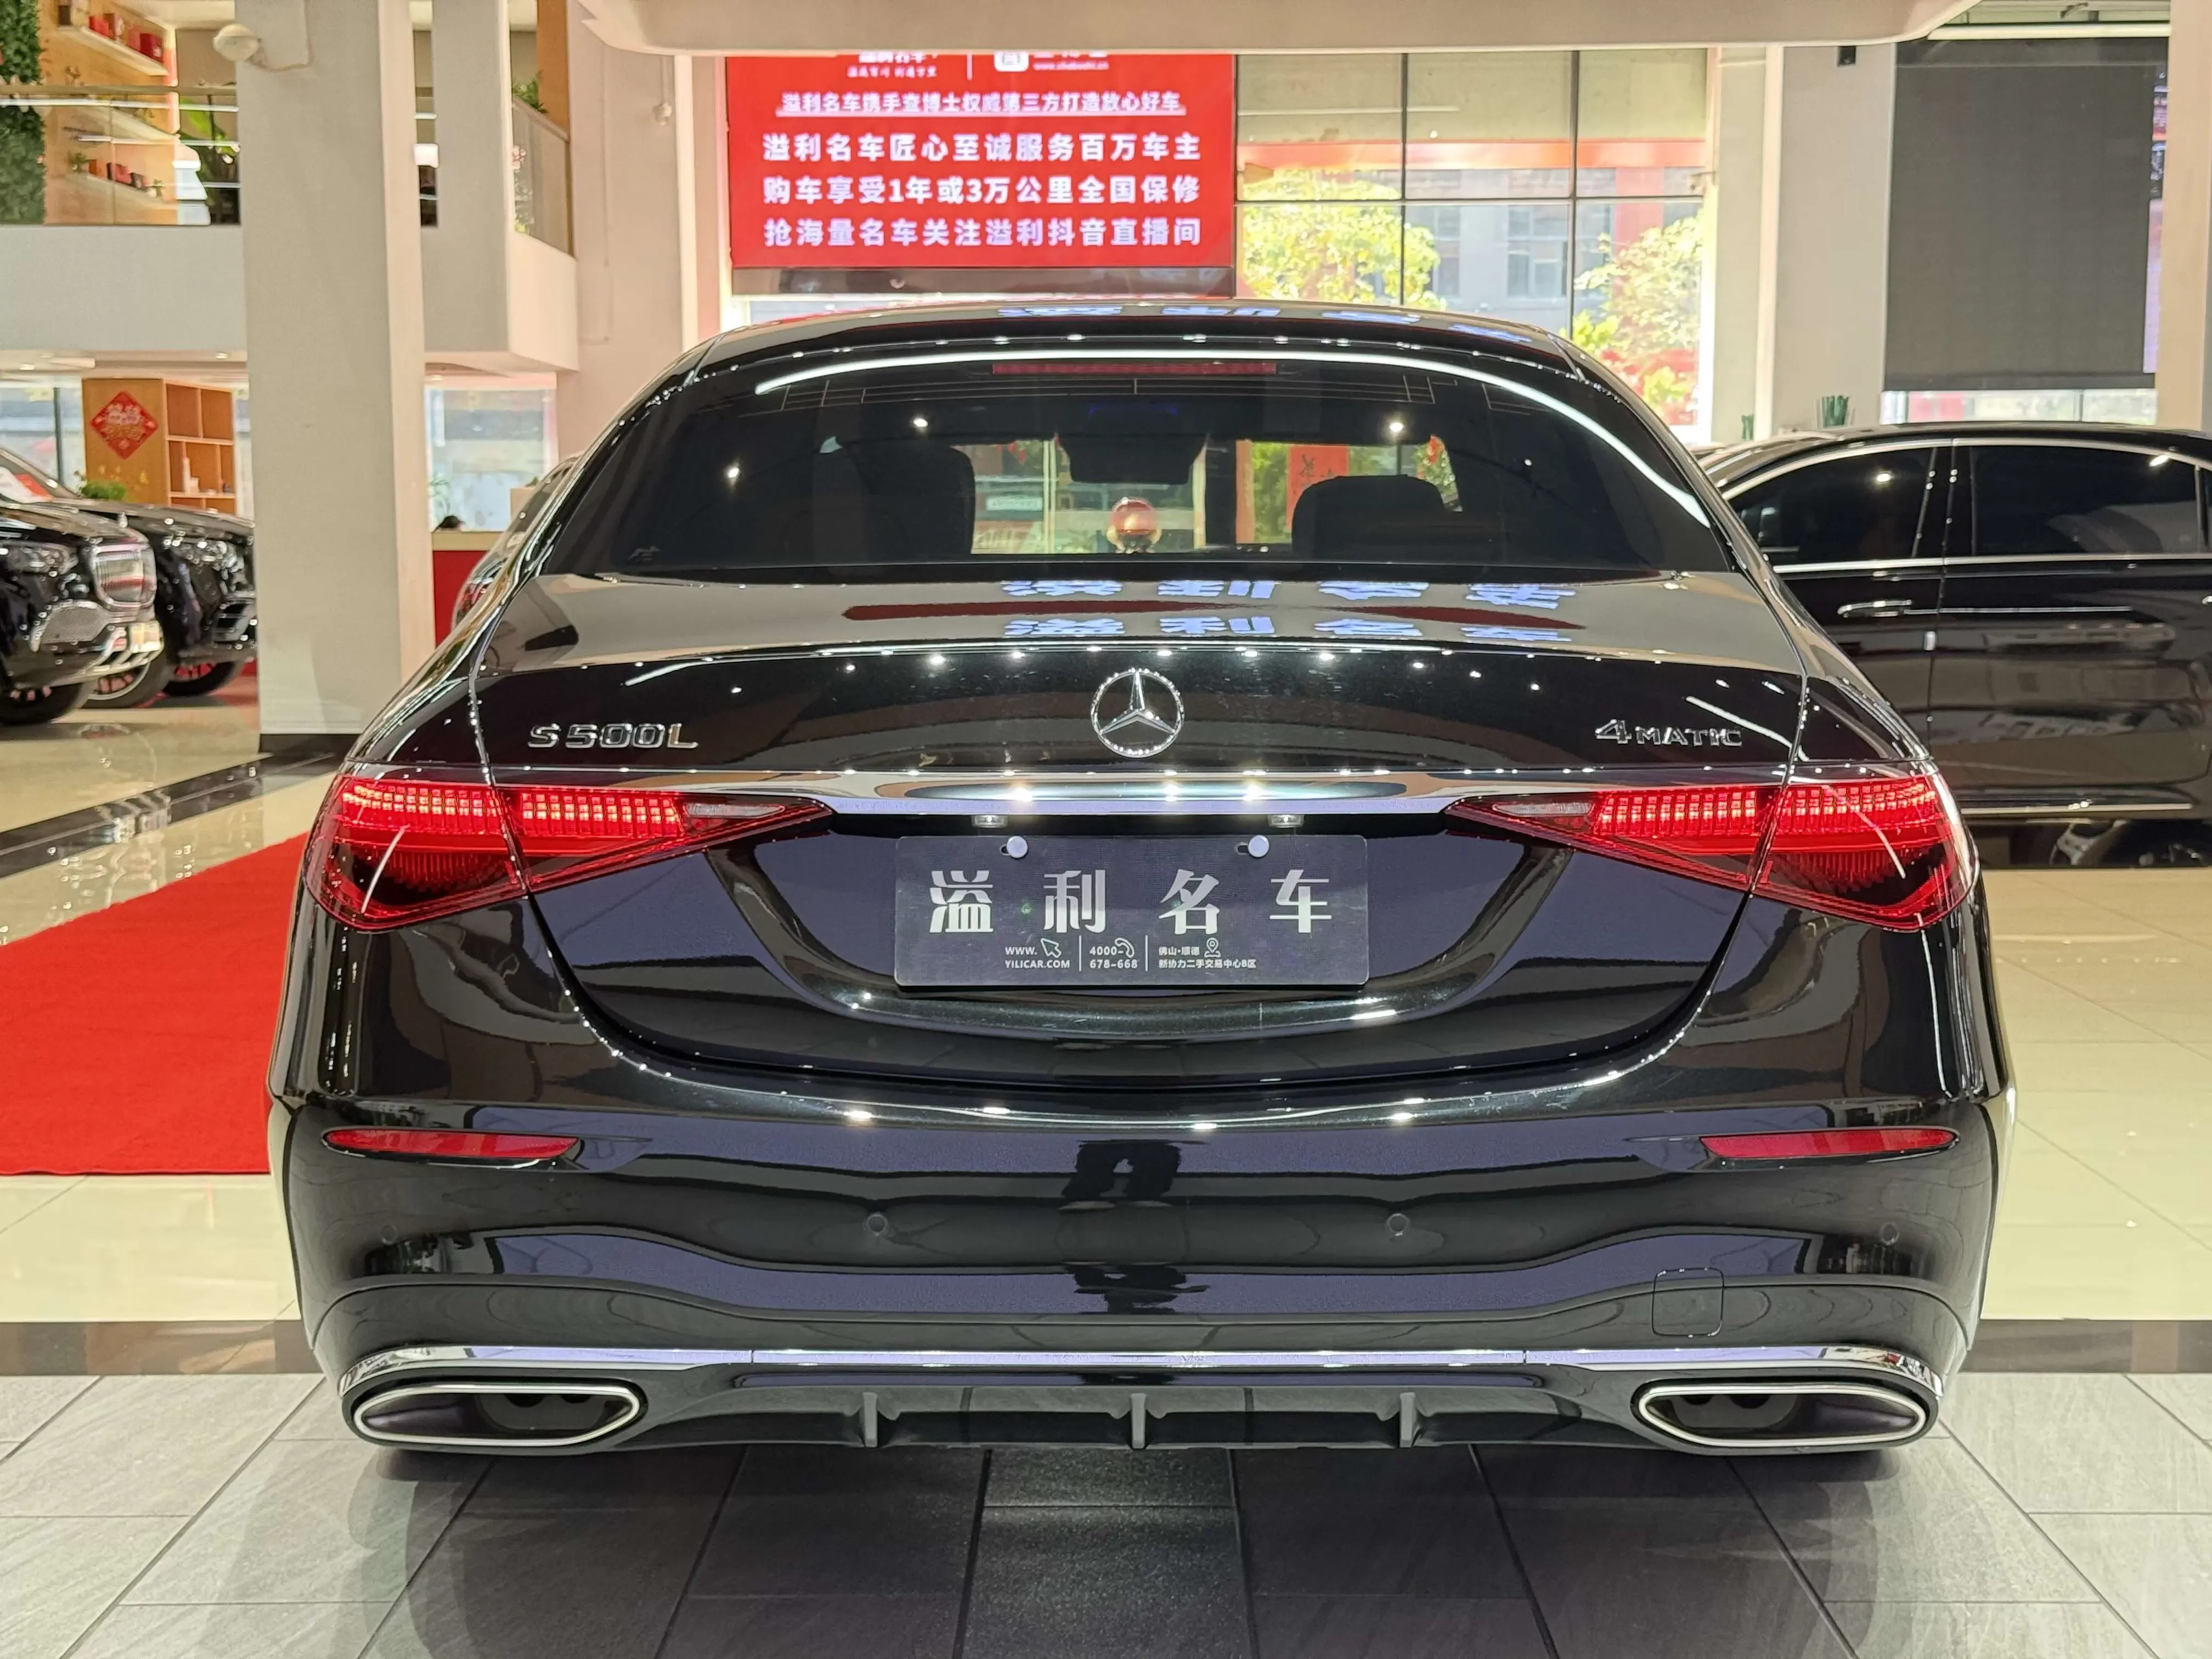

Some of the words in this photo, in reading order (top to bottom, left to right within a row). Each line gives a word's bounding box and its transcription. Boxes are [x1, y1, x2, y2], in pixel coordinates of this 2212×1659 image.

[763, 132, 1200, 162] 溢利名车匠心至诚服务百万车主
[763, 175, 1200, 204] 购车享受1年或3万公里全国保修
[764, 217, 1200, 246] 抢海量名车关注溢利抖音直播间
[930, 869, 1332, 933] 溢利名车
[1005, 947, 1037, 956] WWW.
[1005, 960, 1070, 968] YILICAR.COM
[1090, 959, 1138, 969] 678-668
